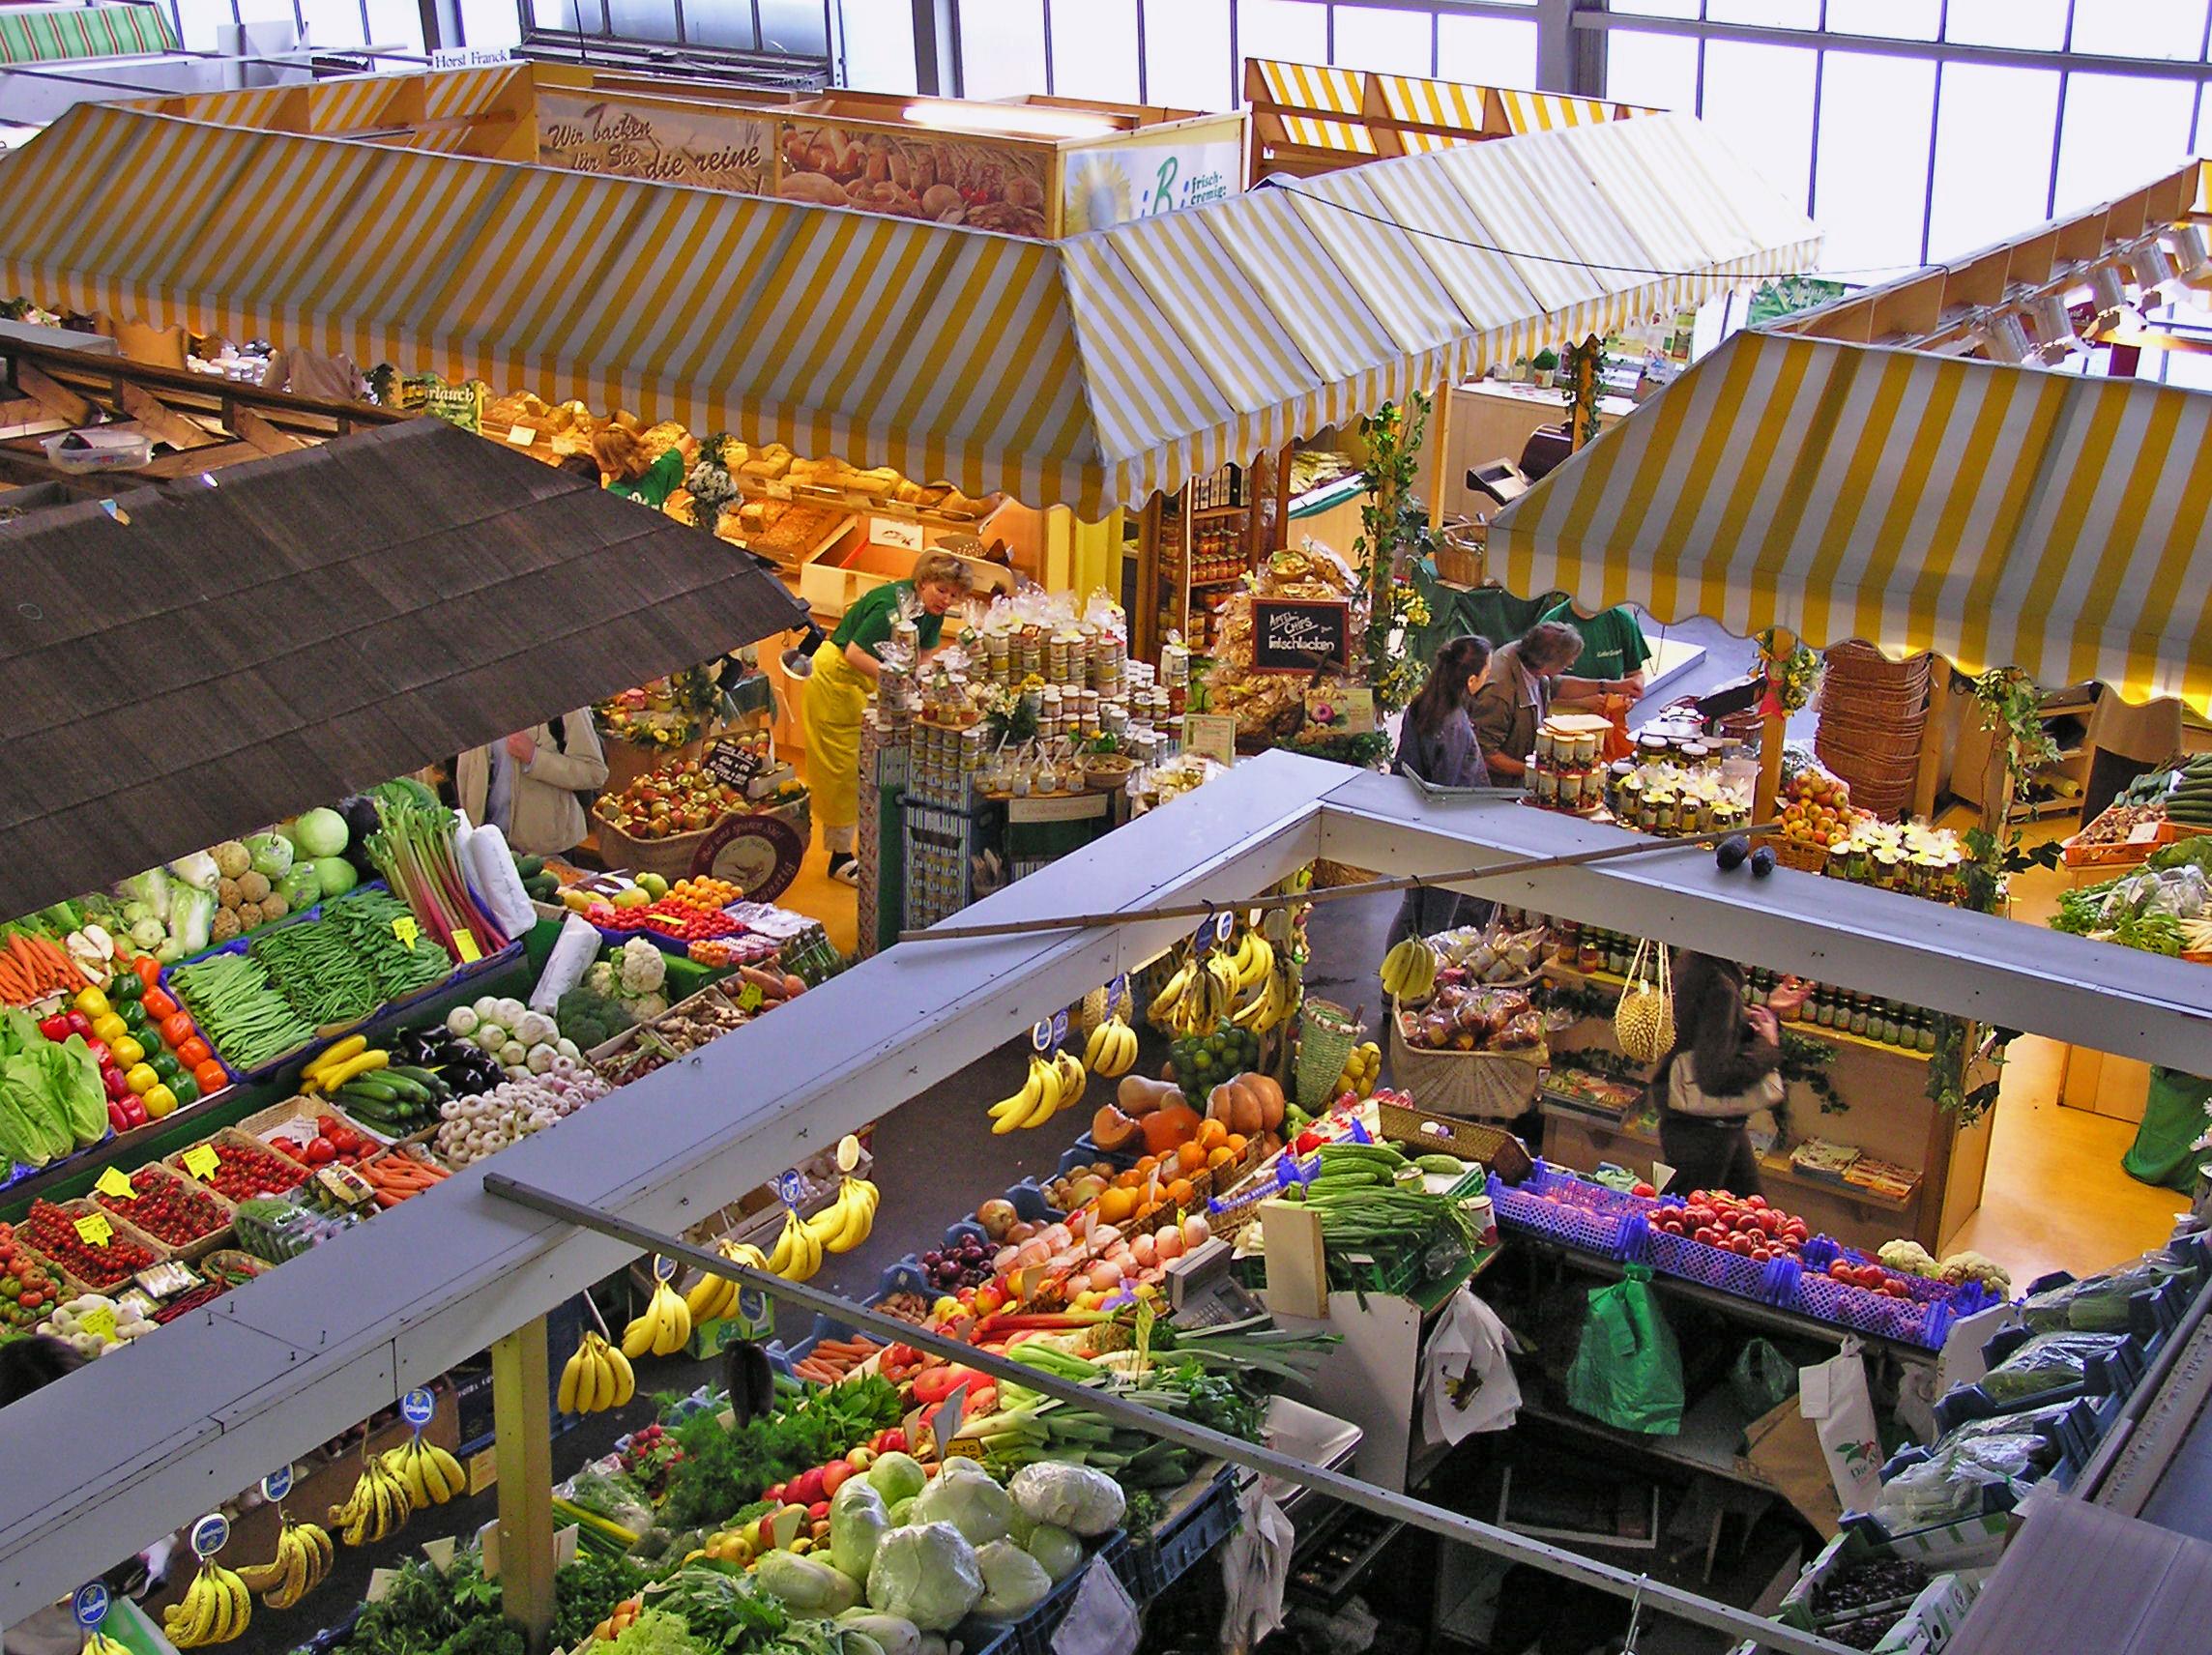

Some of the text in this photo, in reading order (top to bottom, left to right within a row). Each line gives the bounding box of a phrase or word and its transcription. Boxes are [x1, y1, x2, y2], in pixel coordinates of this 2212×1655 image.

[435, 50, 507, 69] Horst Franck
[547, 106, 652, 147] Wir backen
[608, 144, 639, 167] Sie
[644, 145, 762, 181] die reine
